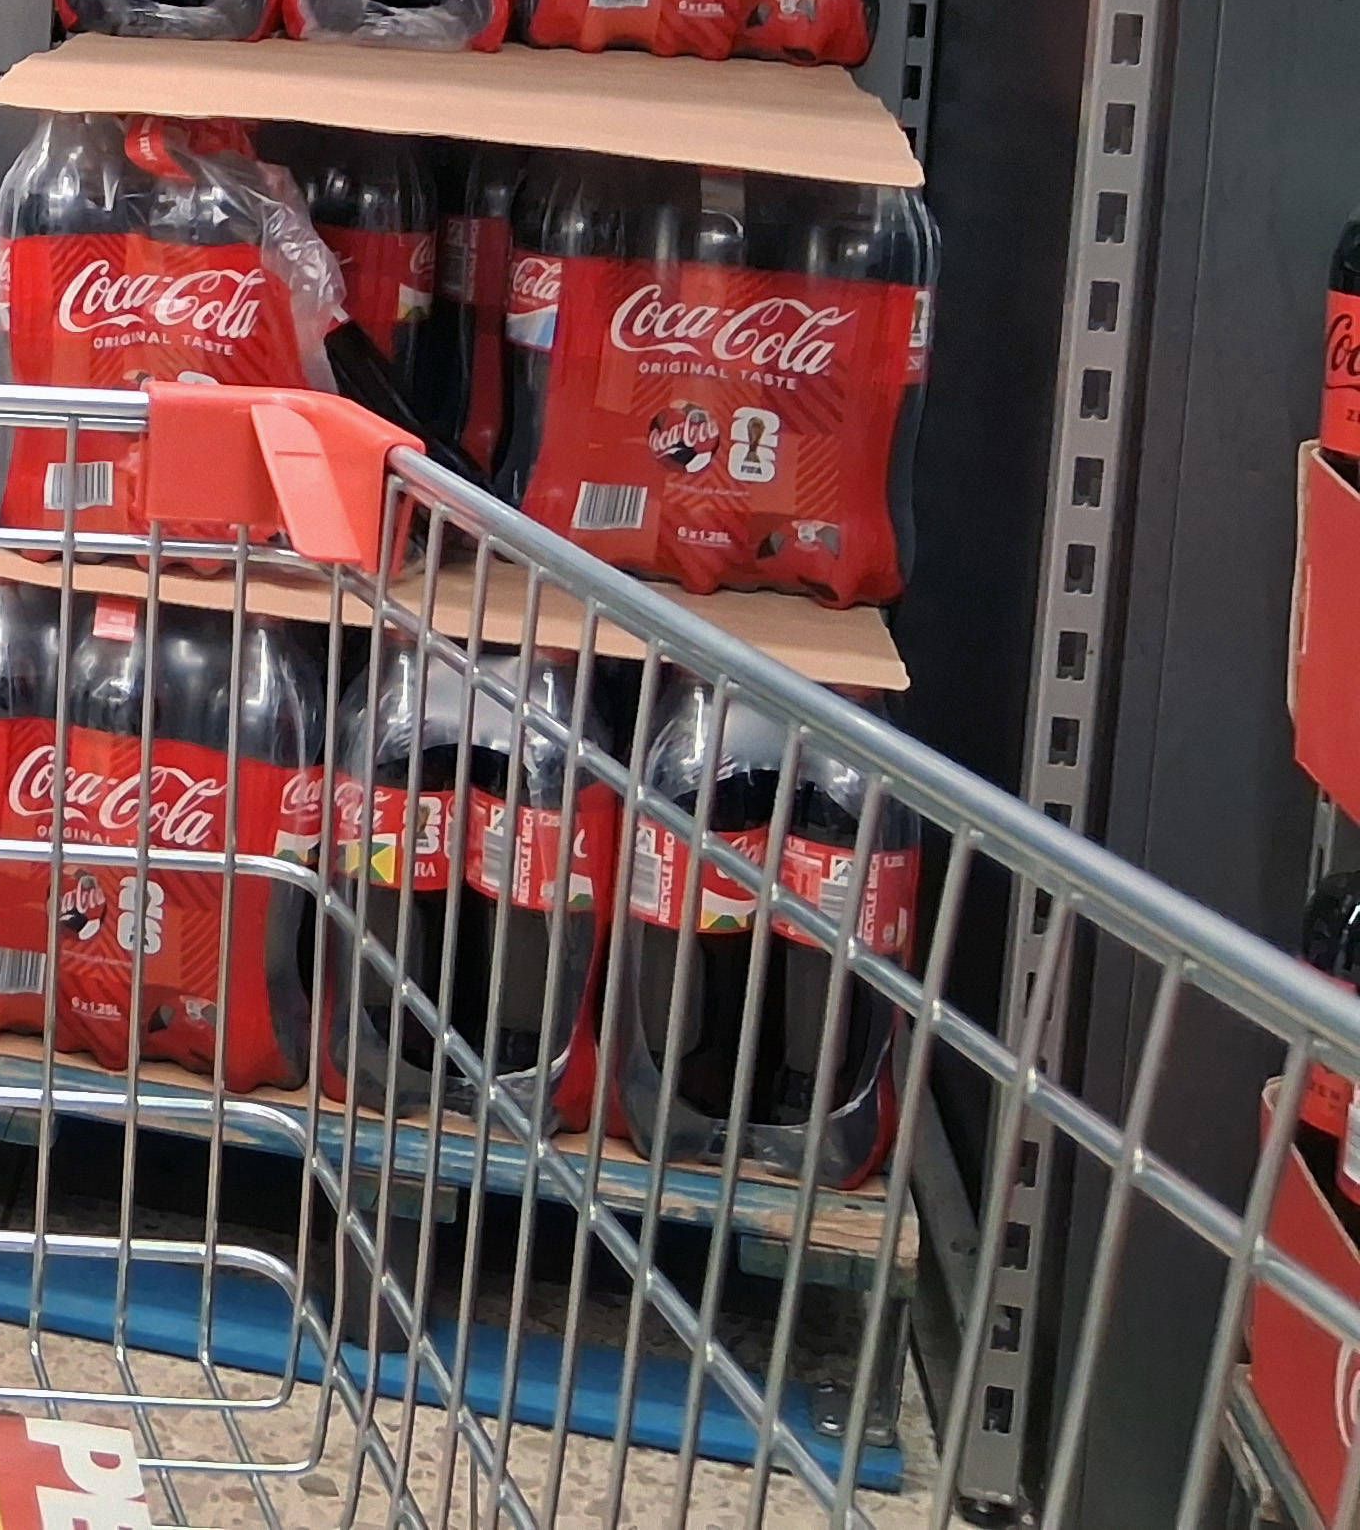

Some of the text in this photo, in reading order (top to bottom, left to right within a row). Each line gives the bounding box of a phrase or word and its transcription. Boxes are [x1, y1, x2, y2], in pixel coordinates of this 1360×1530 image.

[58, 259, 266, 338] Coca-Cola
[93, 331, 234, 356] ORIGINAL TASTE
[610, 284, 857, 376] Coca-Cola
[638, 361, 798, 390] ORIGINAL TASTE
[8, 745, 229, 846] Coca-Cola
[37, 825, 112, 846] OGINAL
[414, 862, 437, 878] RA
[517, 845, 532, 904] RECYCLE
